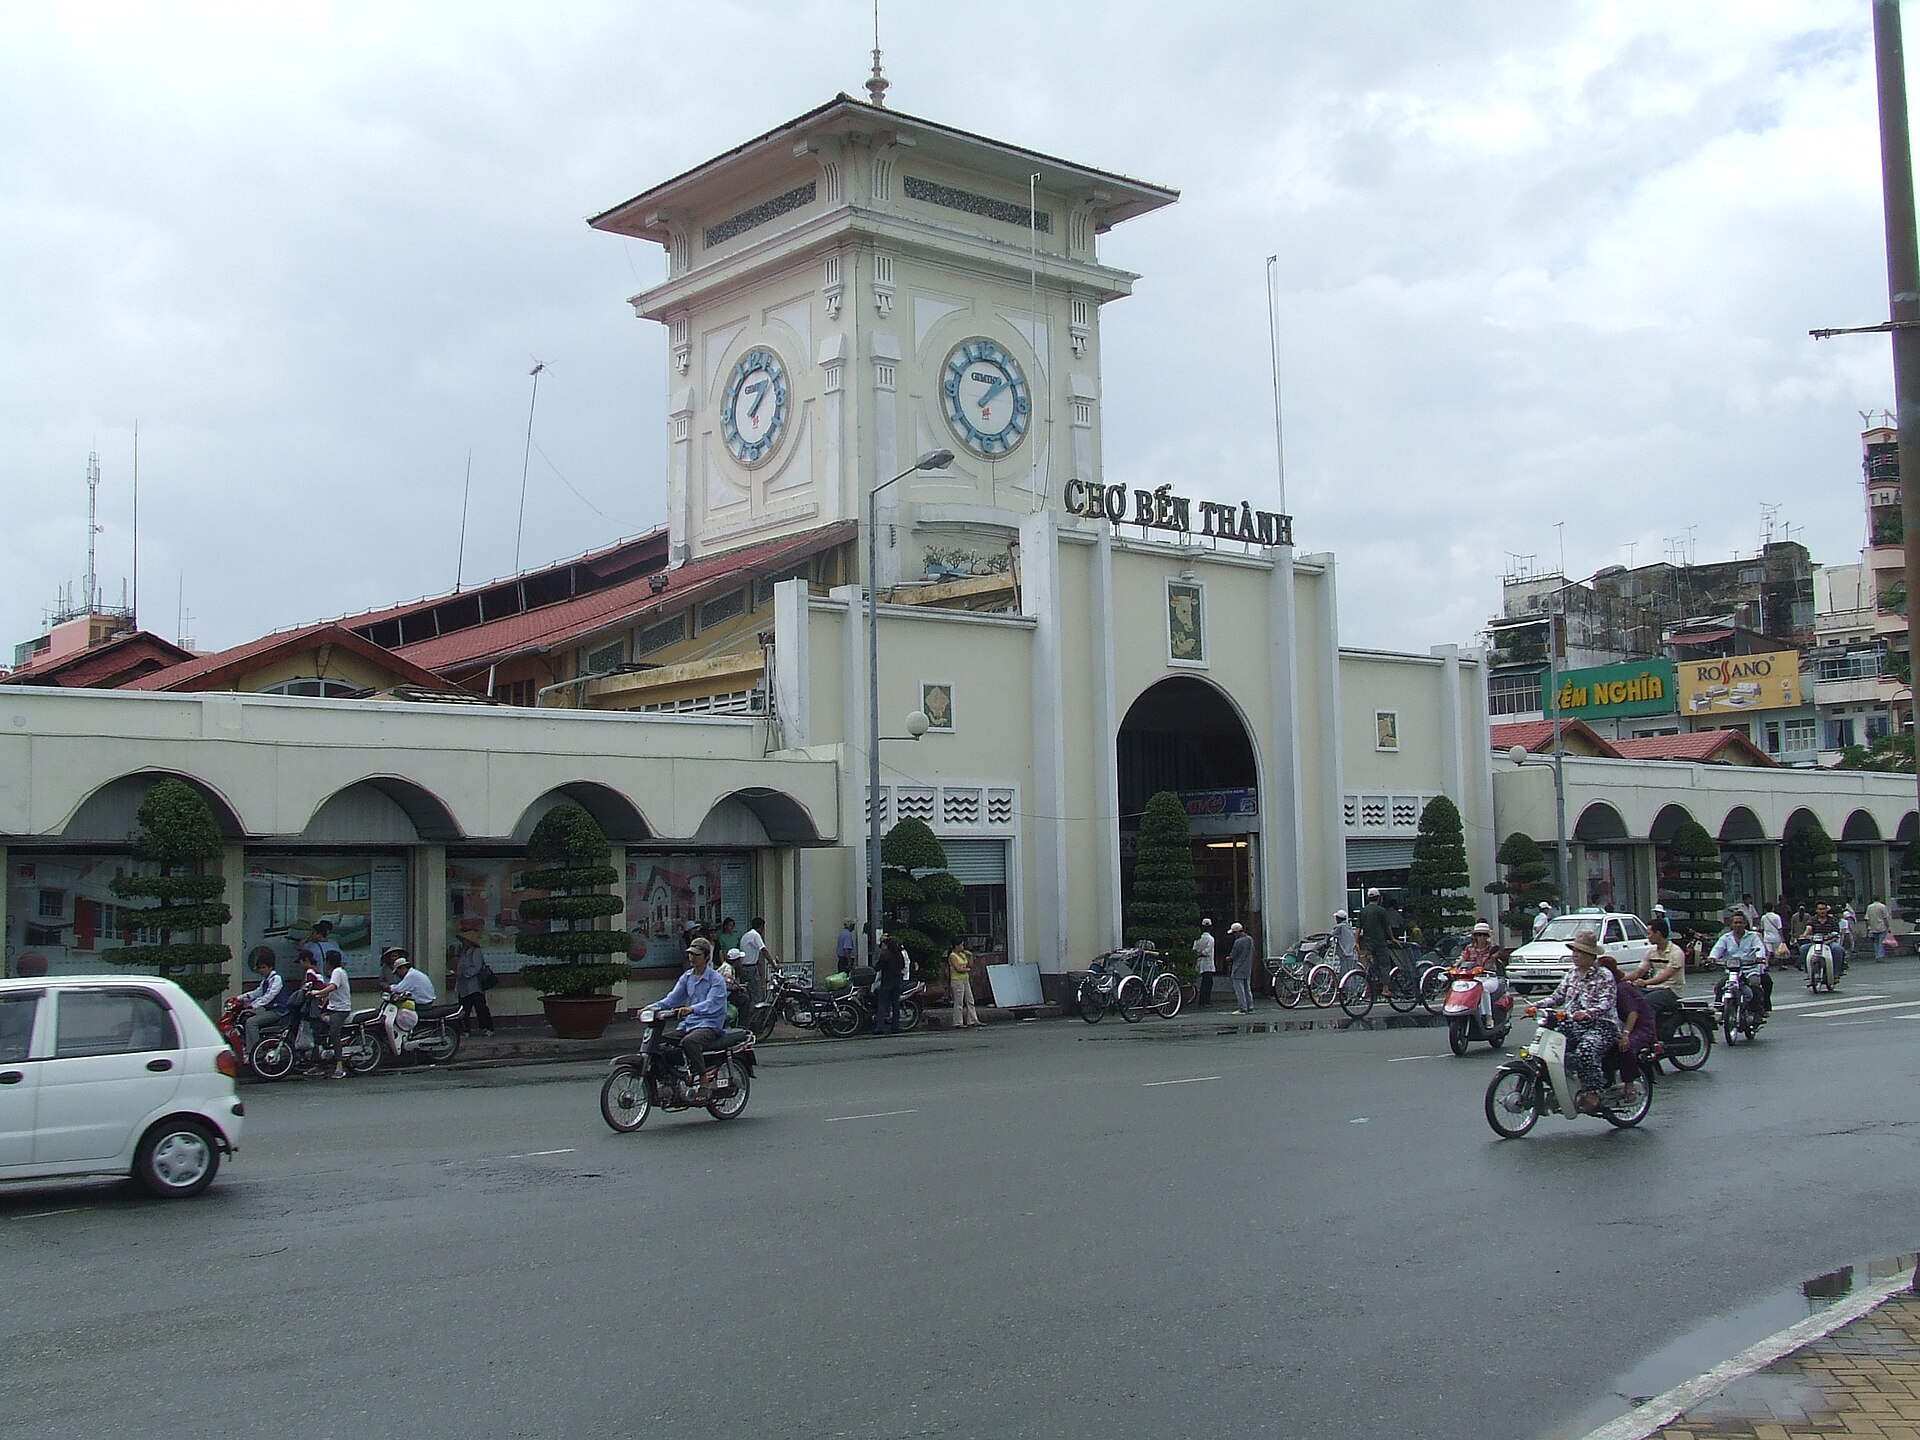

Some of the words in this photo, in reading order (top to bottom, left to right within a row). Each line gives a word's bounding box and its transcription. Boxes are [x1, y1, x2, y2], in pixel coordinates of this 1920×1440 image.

[1064, 478, 1127, 525] CHỢ
[1134, 483, 1191, 532] BẾN
[1199, 500, 1295, 547] THÀNH
[1594, 672, 1663, 705] NGHĨA
[1697, 660, 1771, 685] ROSSANO
